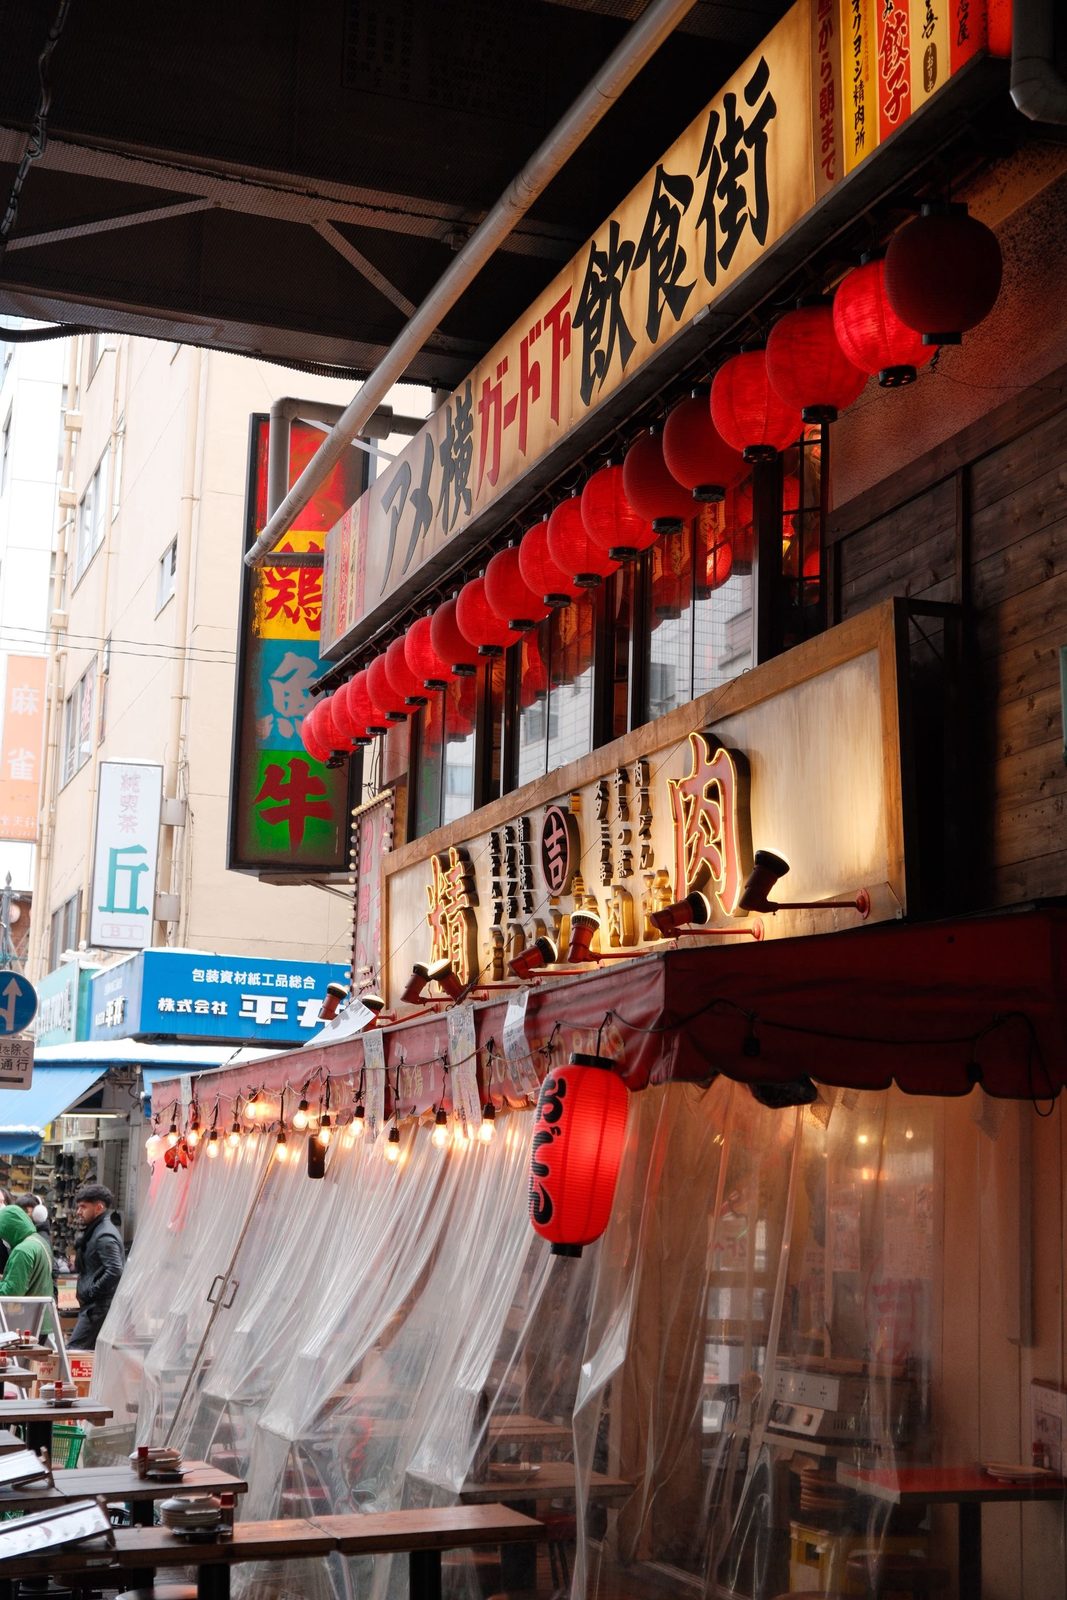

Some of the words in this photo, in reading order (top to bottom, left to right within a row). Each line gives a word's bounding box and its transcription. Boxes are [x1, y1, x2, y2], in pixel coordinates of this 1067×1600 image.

[8, 684, 40, 780] 麻雀
[118, 773, 141, 834] 純喫茶
[254, 758, 336, 852] 牛
[97, 843, 150, 916] 丘
[426, 846, 471, 992] 精
[666, 732, 742, 917] 肉
[158, 997, 228, 1016] 株式会社
[192, 968, 316, 990] 包装資材紙工品総合
[1, 1058, 29, 1071] 通行
